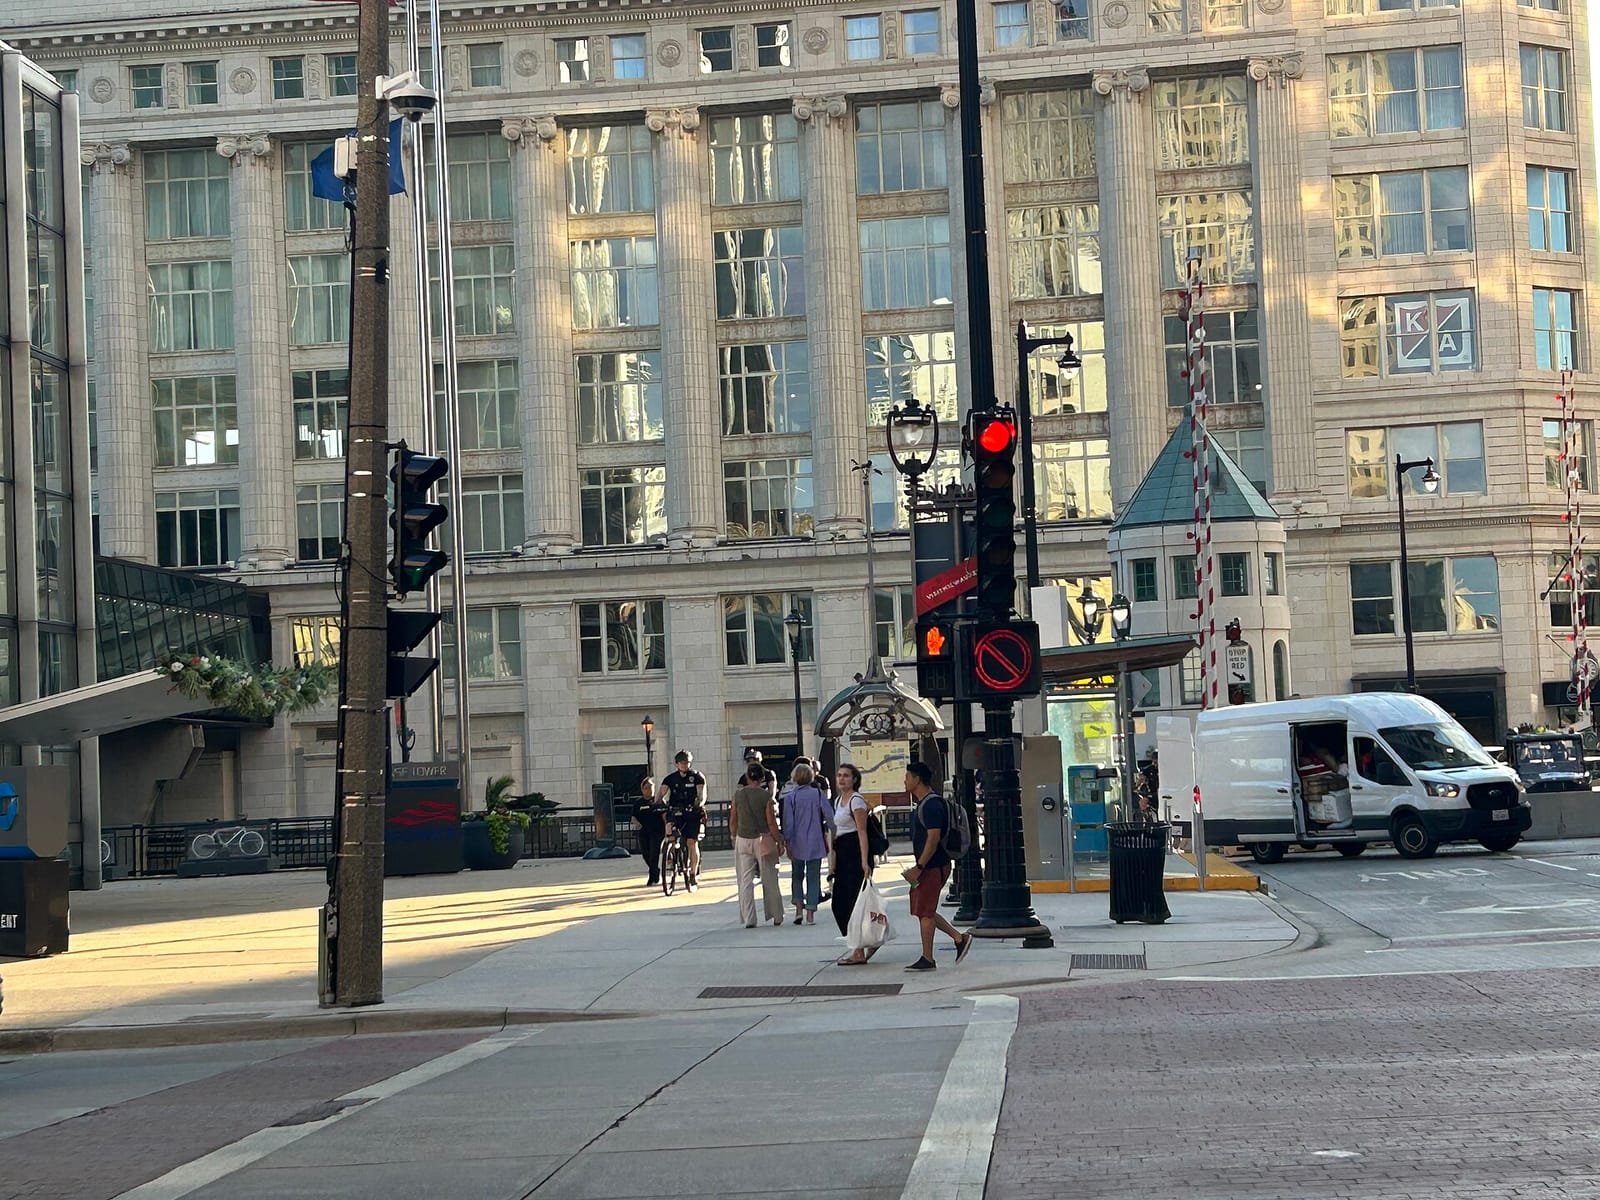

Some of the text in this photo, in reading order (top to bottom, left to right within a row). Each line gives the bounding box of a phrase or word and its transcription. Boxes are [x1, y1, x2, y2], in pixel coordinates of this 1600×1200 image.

[1406, 311, 1424, 332] K
[1439, 333, 1456, 351] A
[1231, 662, 1245, 670] RED
[412, 765, 447, 777] TOWER
